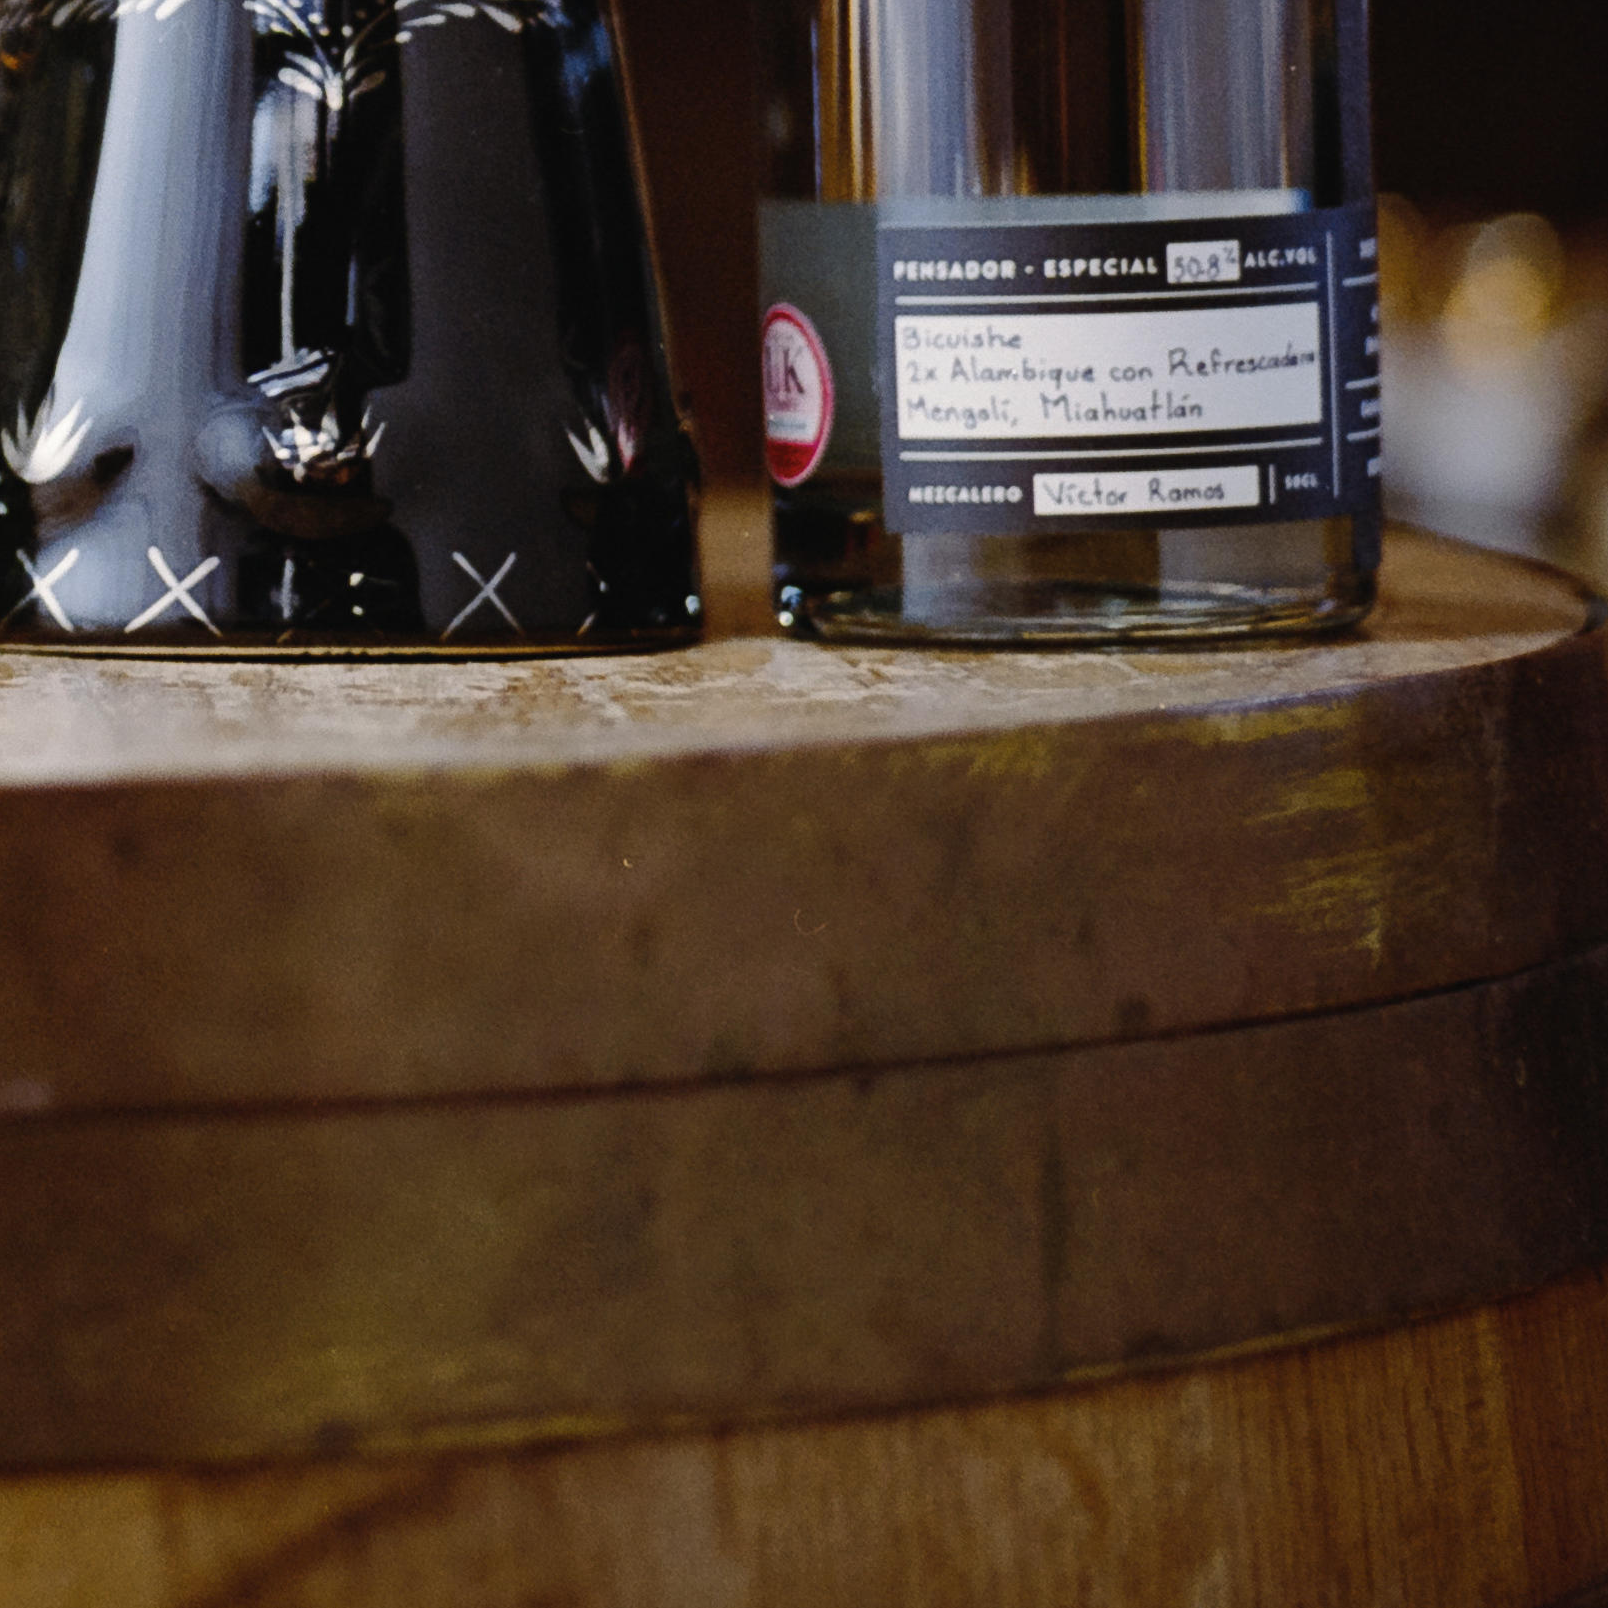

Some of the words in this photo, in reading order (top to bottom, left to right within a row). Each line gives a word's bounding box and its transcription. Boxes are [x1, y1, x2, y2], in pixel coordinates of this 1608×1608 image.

[893, 259, 1016, 282] PENSADOR
[1042, 256, 1159, 279] ESPECIAL
[902, 325, 1023, 350] Bicuishe
[906, 360, 938, 384] 2x
[950, 355, 1097, 391] Alambique
[1109, 367, 1154, 383] con
[1039, 389, 1204, 423] Miahuatlán
[907, 484, 1024, 505] MEZCALERO
[1147, 476, 1227, 504] Ramos
